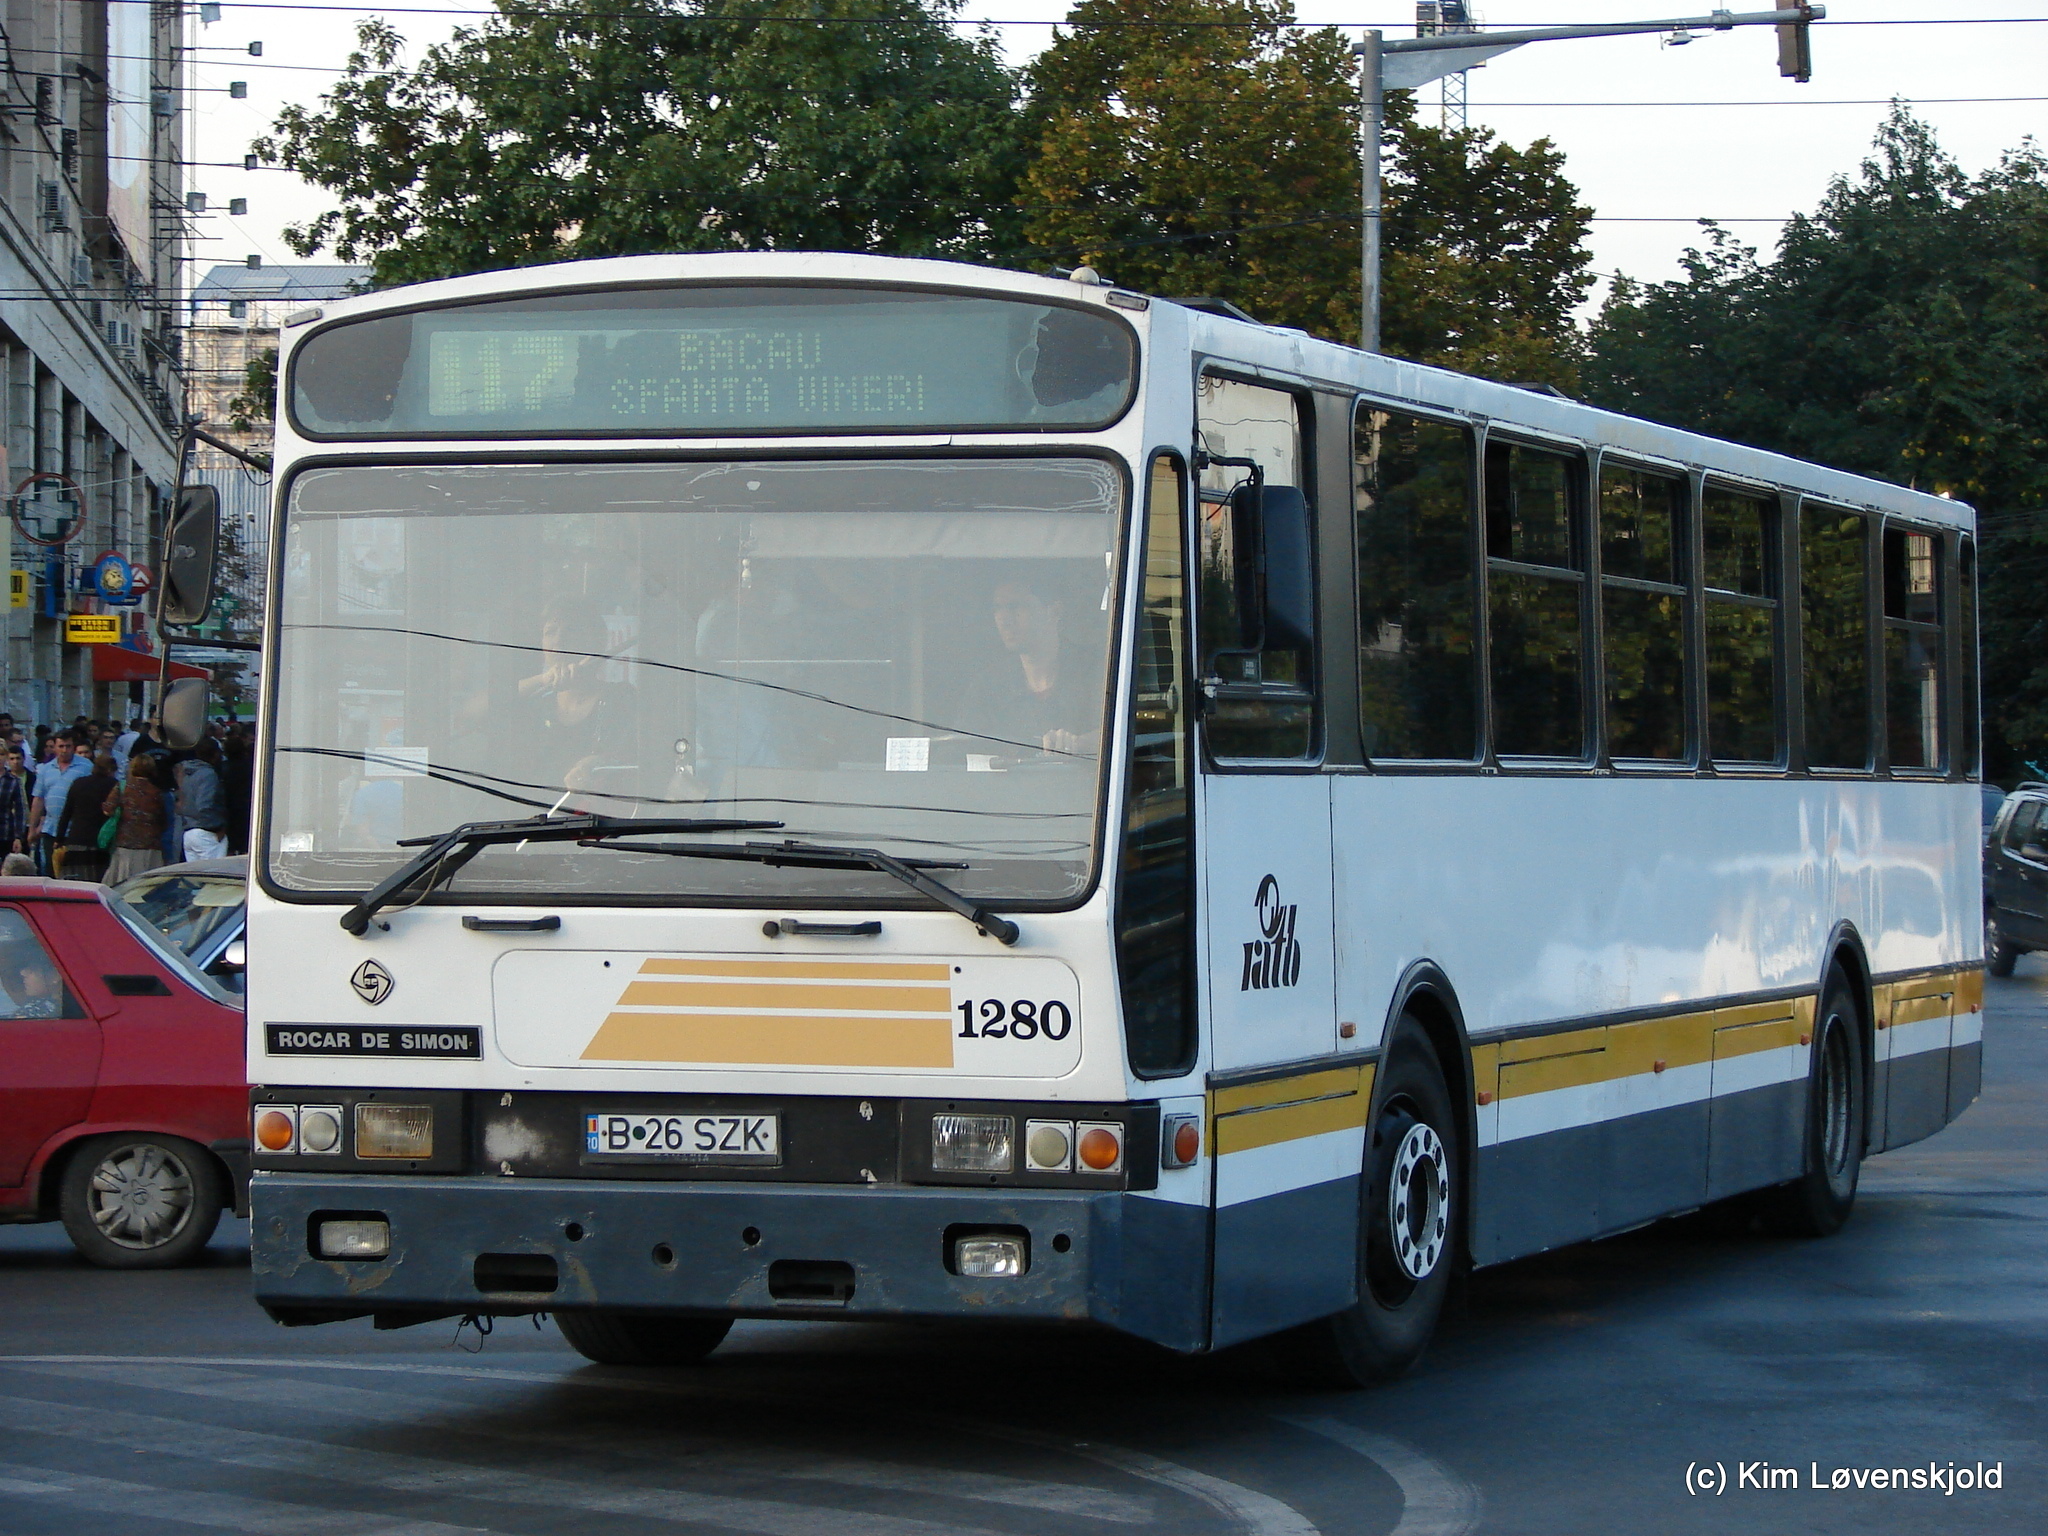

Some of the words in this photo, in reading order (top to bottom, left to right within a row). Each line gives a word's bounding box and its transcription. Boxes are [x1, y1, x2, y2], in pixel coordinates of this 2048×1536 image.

[680, 331, 821, 371] BACAU
[437, 335, 564, 412] 117
[611, 376, 770, 414] SFANTA
[798, 374, 925, 412] VINERI
[957, 998, 1072, 1041] 1280
[278, 1031, 350, 1048] ROCAR
[361, 1032, 390, 1049] DE
[401, 1033, 468, 1050] SIMON
[608, 1117, 630, 1150] B
[645, 1117, 683, 1150] 26
[694, 1118, 766, 1151] SZK
